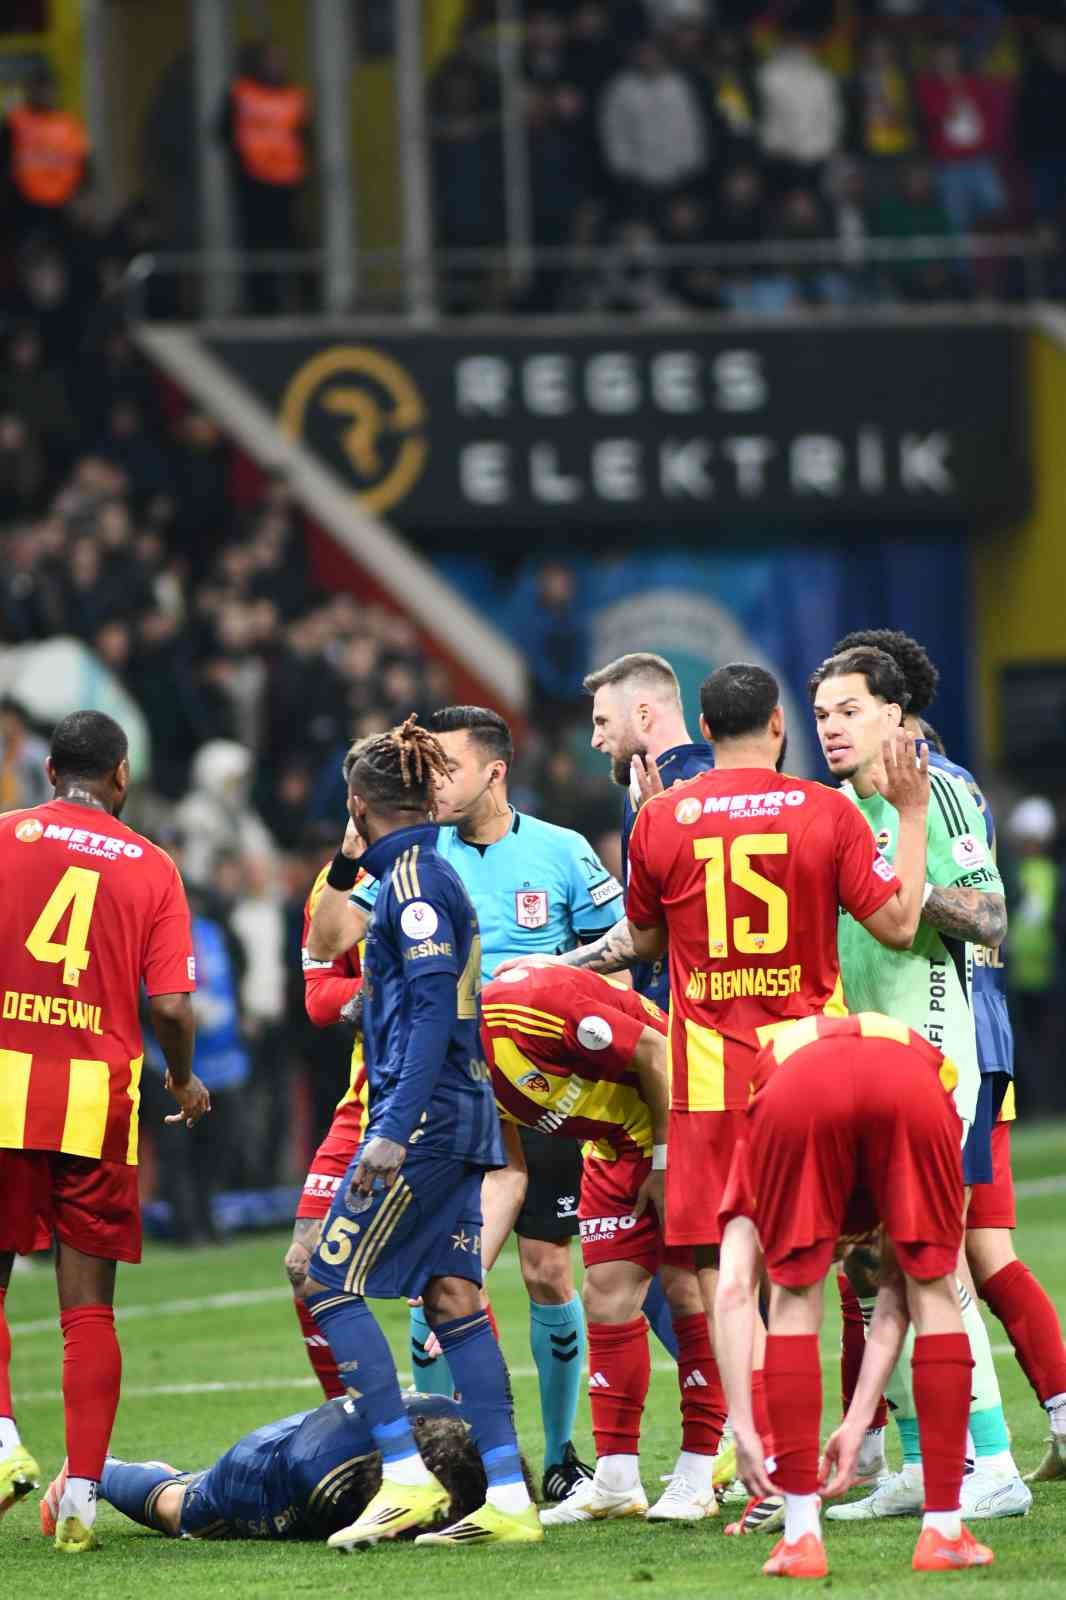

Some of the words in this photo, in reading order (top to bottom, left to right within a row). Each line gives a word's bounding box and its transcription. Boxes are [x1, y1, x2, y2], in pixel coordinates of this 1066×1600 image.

[456, 350, 767, 415] REGES
[703, 790, 806, 814] METRO
[729, 806, 781, 820] HOLDING
[43, 824, 143, 858] METRO
[67, 842, 118, 861] HOLDING
[692, 833, 789, 958] 15
[24, 865, 100, 988] 4
[928, 955, 947, 1013] PORT
[2, 991, 104, 1036] DENSWIL
